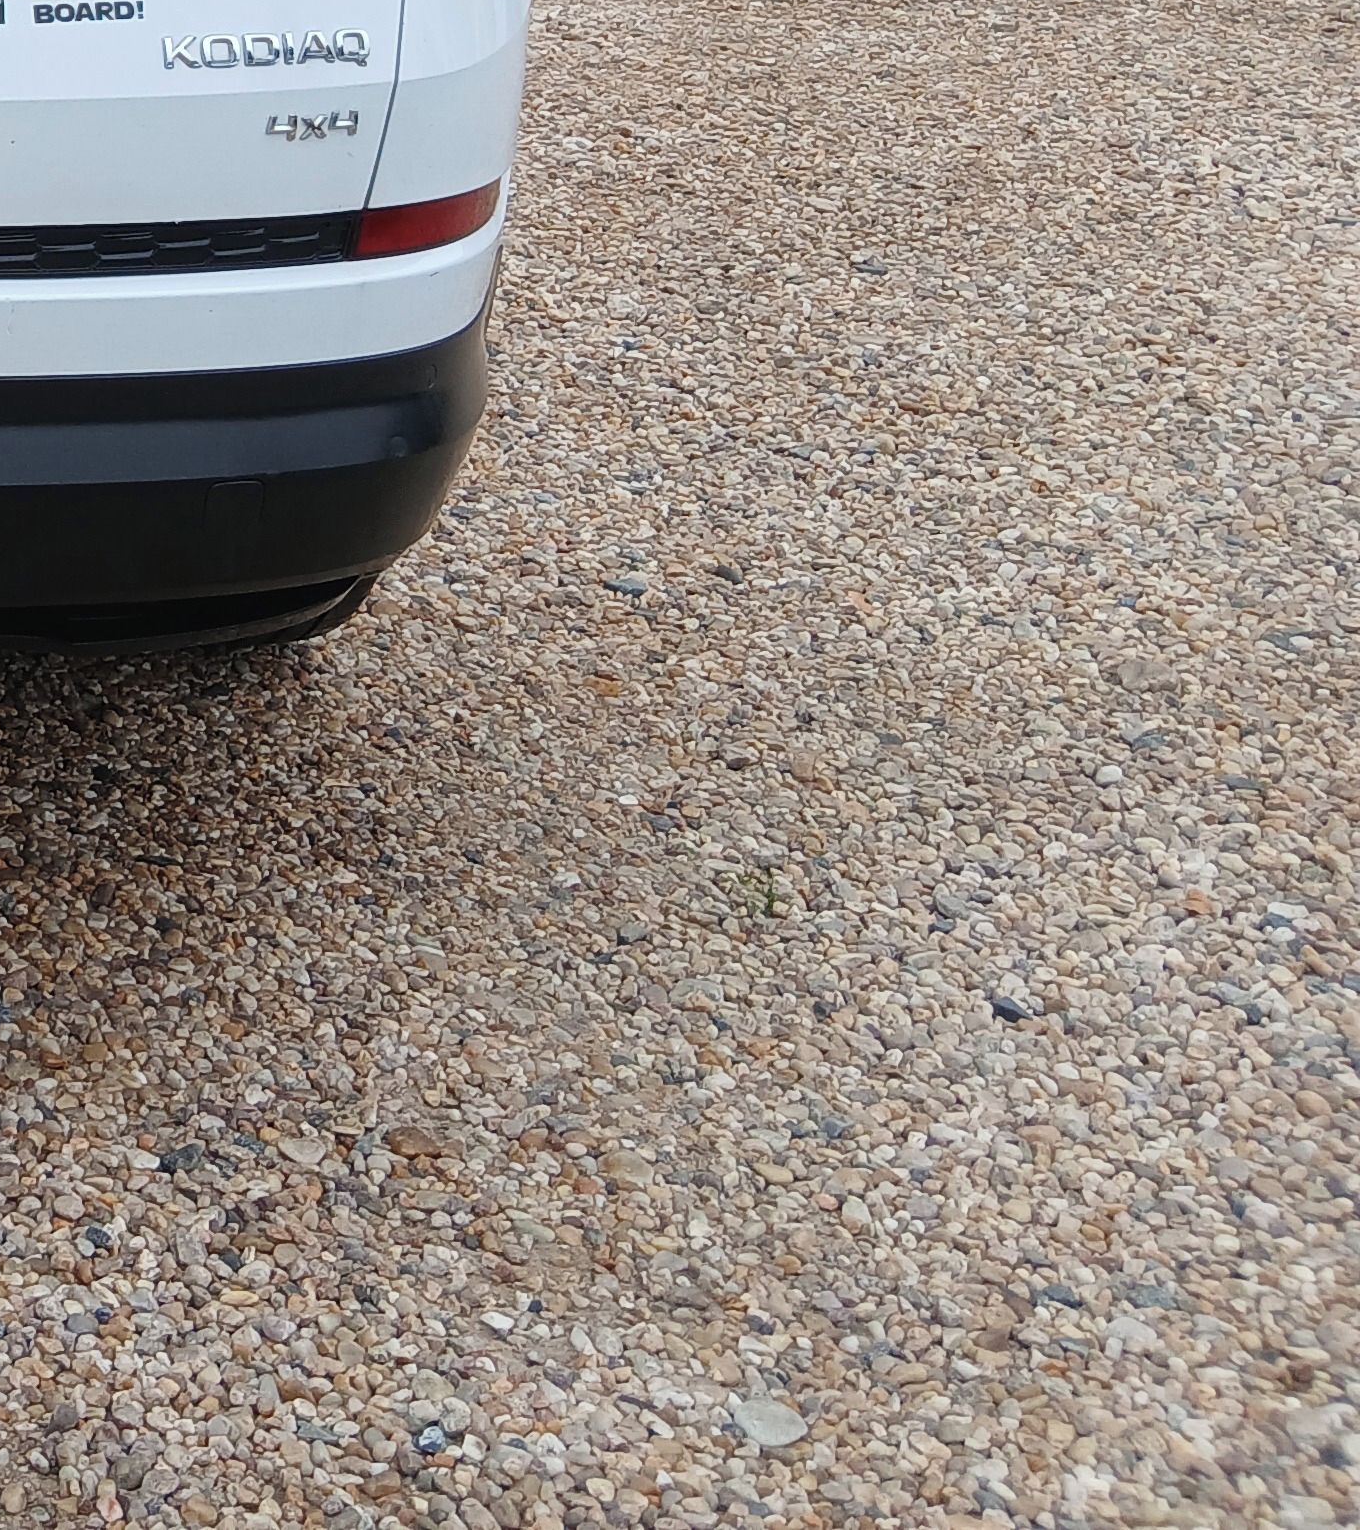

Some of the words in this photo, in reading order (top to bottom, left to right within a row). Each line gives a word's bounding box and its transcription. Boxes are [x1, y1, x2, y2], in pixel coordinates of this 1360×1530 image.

[33, 0, 145, 24] BOARD!
[161, 28, 371, 70] KODIAQ
[265, 109, 360, 143] 4x4
